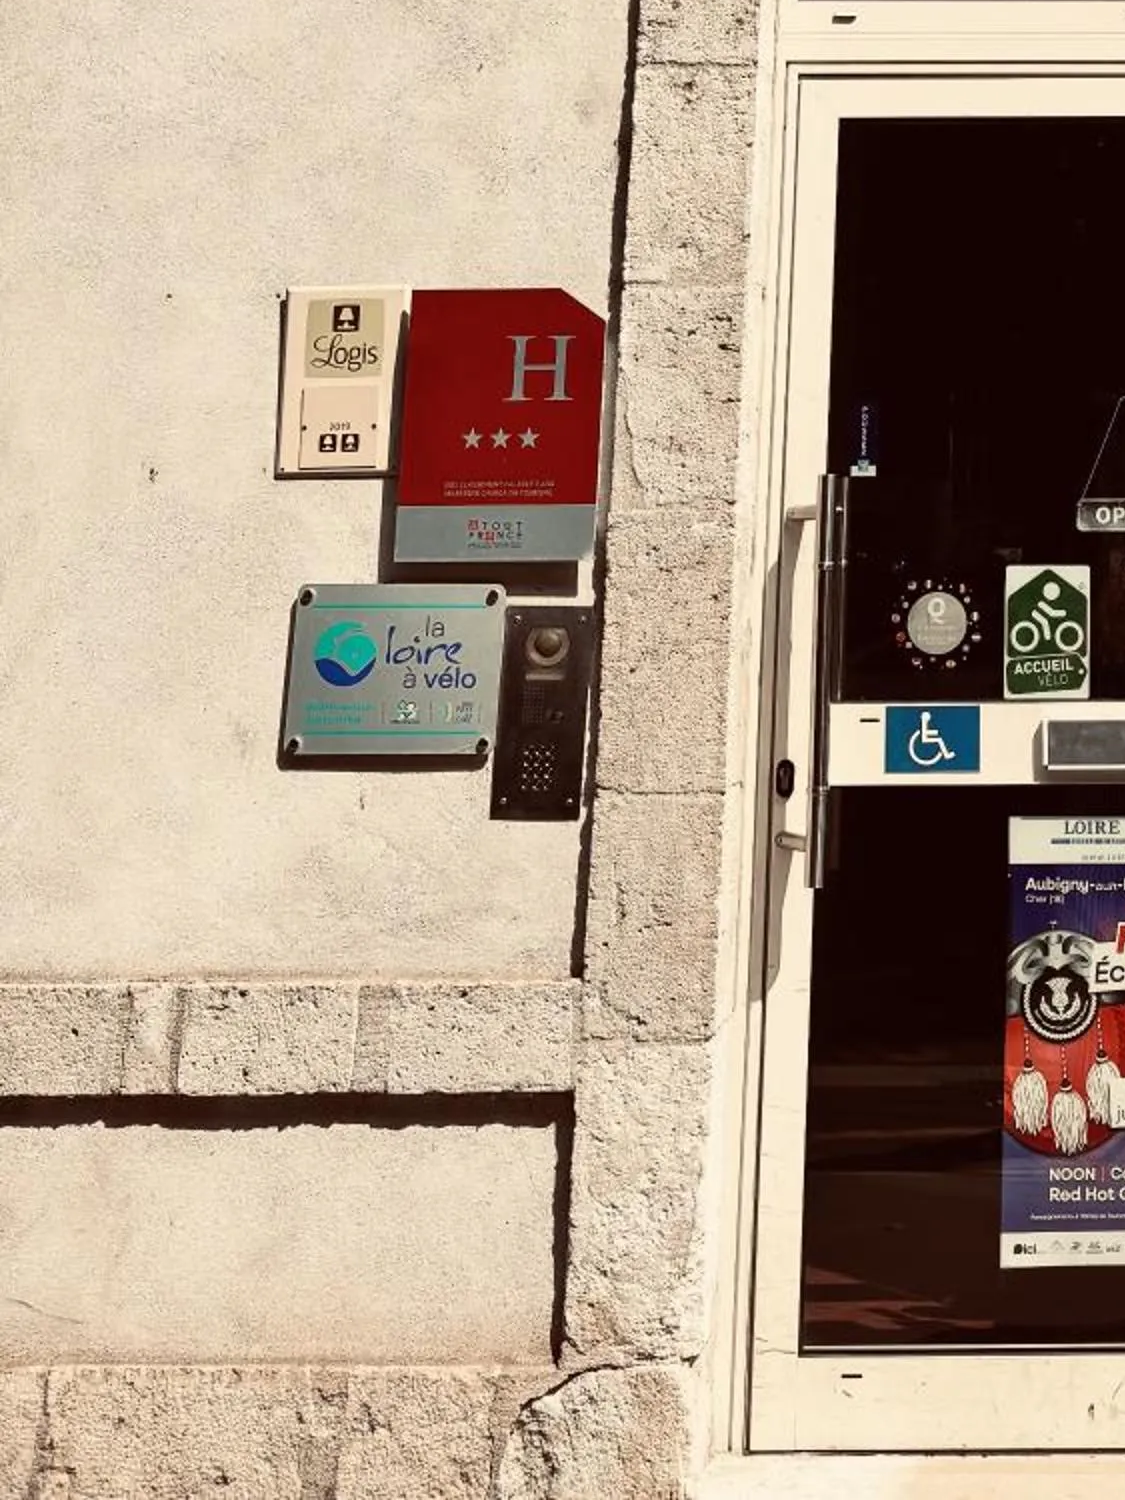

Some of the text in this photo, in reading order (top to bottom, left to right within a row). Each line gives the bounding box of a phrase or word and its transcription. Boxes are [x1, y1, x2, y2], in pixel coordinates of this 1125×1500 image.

[310, 333, 378, 372] Logis
[503, 335, 577, 401] H
[425, 616, 446, 637] la
[385, 626, 463, 665] loire
[1014, 660, 1075, 676] ACCUEIL
[403, 666, 477, 690] à vélo
[1037, 671, 1069, 687] VÉLO
[1064, 819, 1121, 835] LOIRE
[1049, 1167, 1096, 1181] NOON
[1049, 1187, 1081, 1202] Red
[1085, 1187, 1115, 1202] Hot
